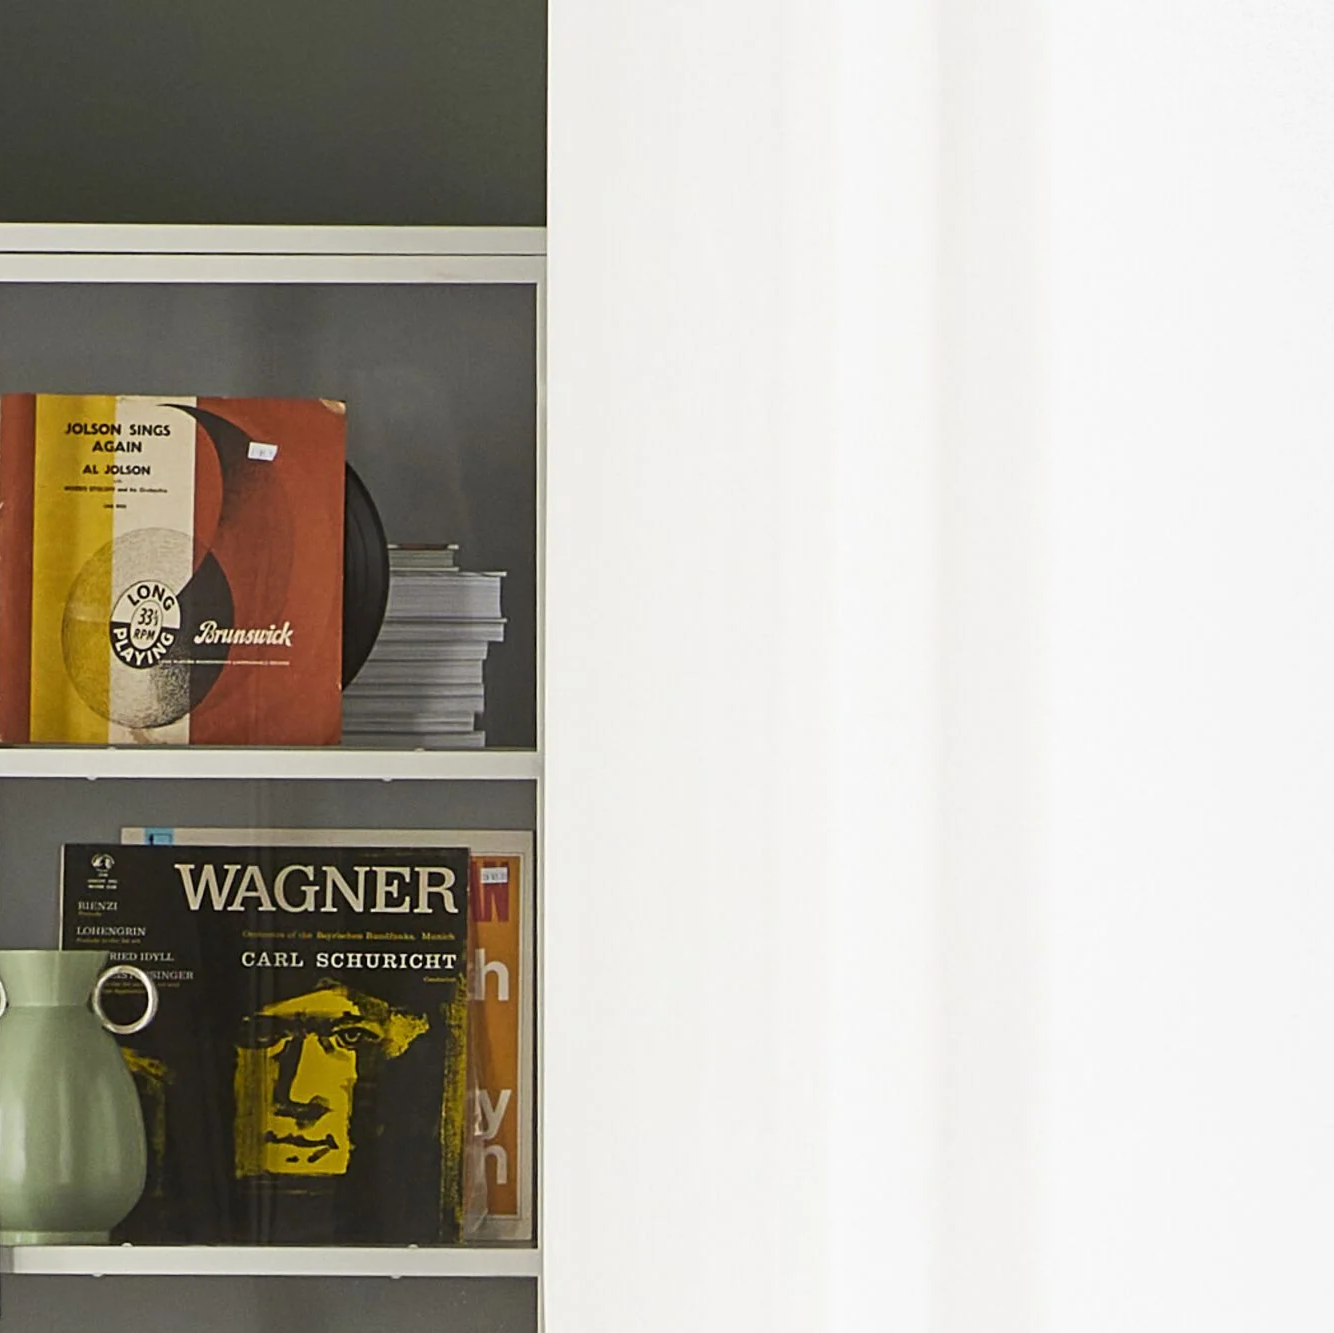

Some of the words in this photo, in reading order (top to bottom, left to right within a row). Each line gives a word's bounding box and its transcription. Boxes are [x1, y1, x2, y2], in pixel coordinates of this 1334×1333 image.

[65, 423, 122, 436] JOLSON
[129, 424, 171, 437] SINGS
[92, 440, 143, 453] AGAIN
[82, 464, 99, 475] AL
[105, 465, 151, 476] JOLSON
[127, 585, 175, 611] LONG
[133, 628, 156, 640] RPM
[193, 620, 293, 647] Brunswick
[113, 627, 174, 666] PLAYING
[174, 863, 459, 914] WAGNER
[77, 901, 118, 911] RIENZI
[76, 926, 147, 937] LOHENGRIN
[241, 952, 304, 967] CARL
[316, 953, 457, 969] SCHURICHT
